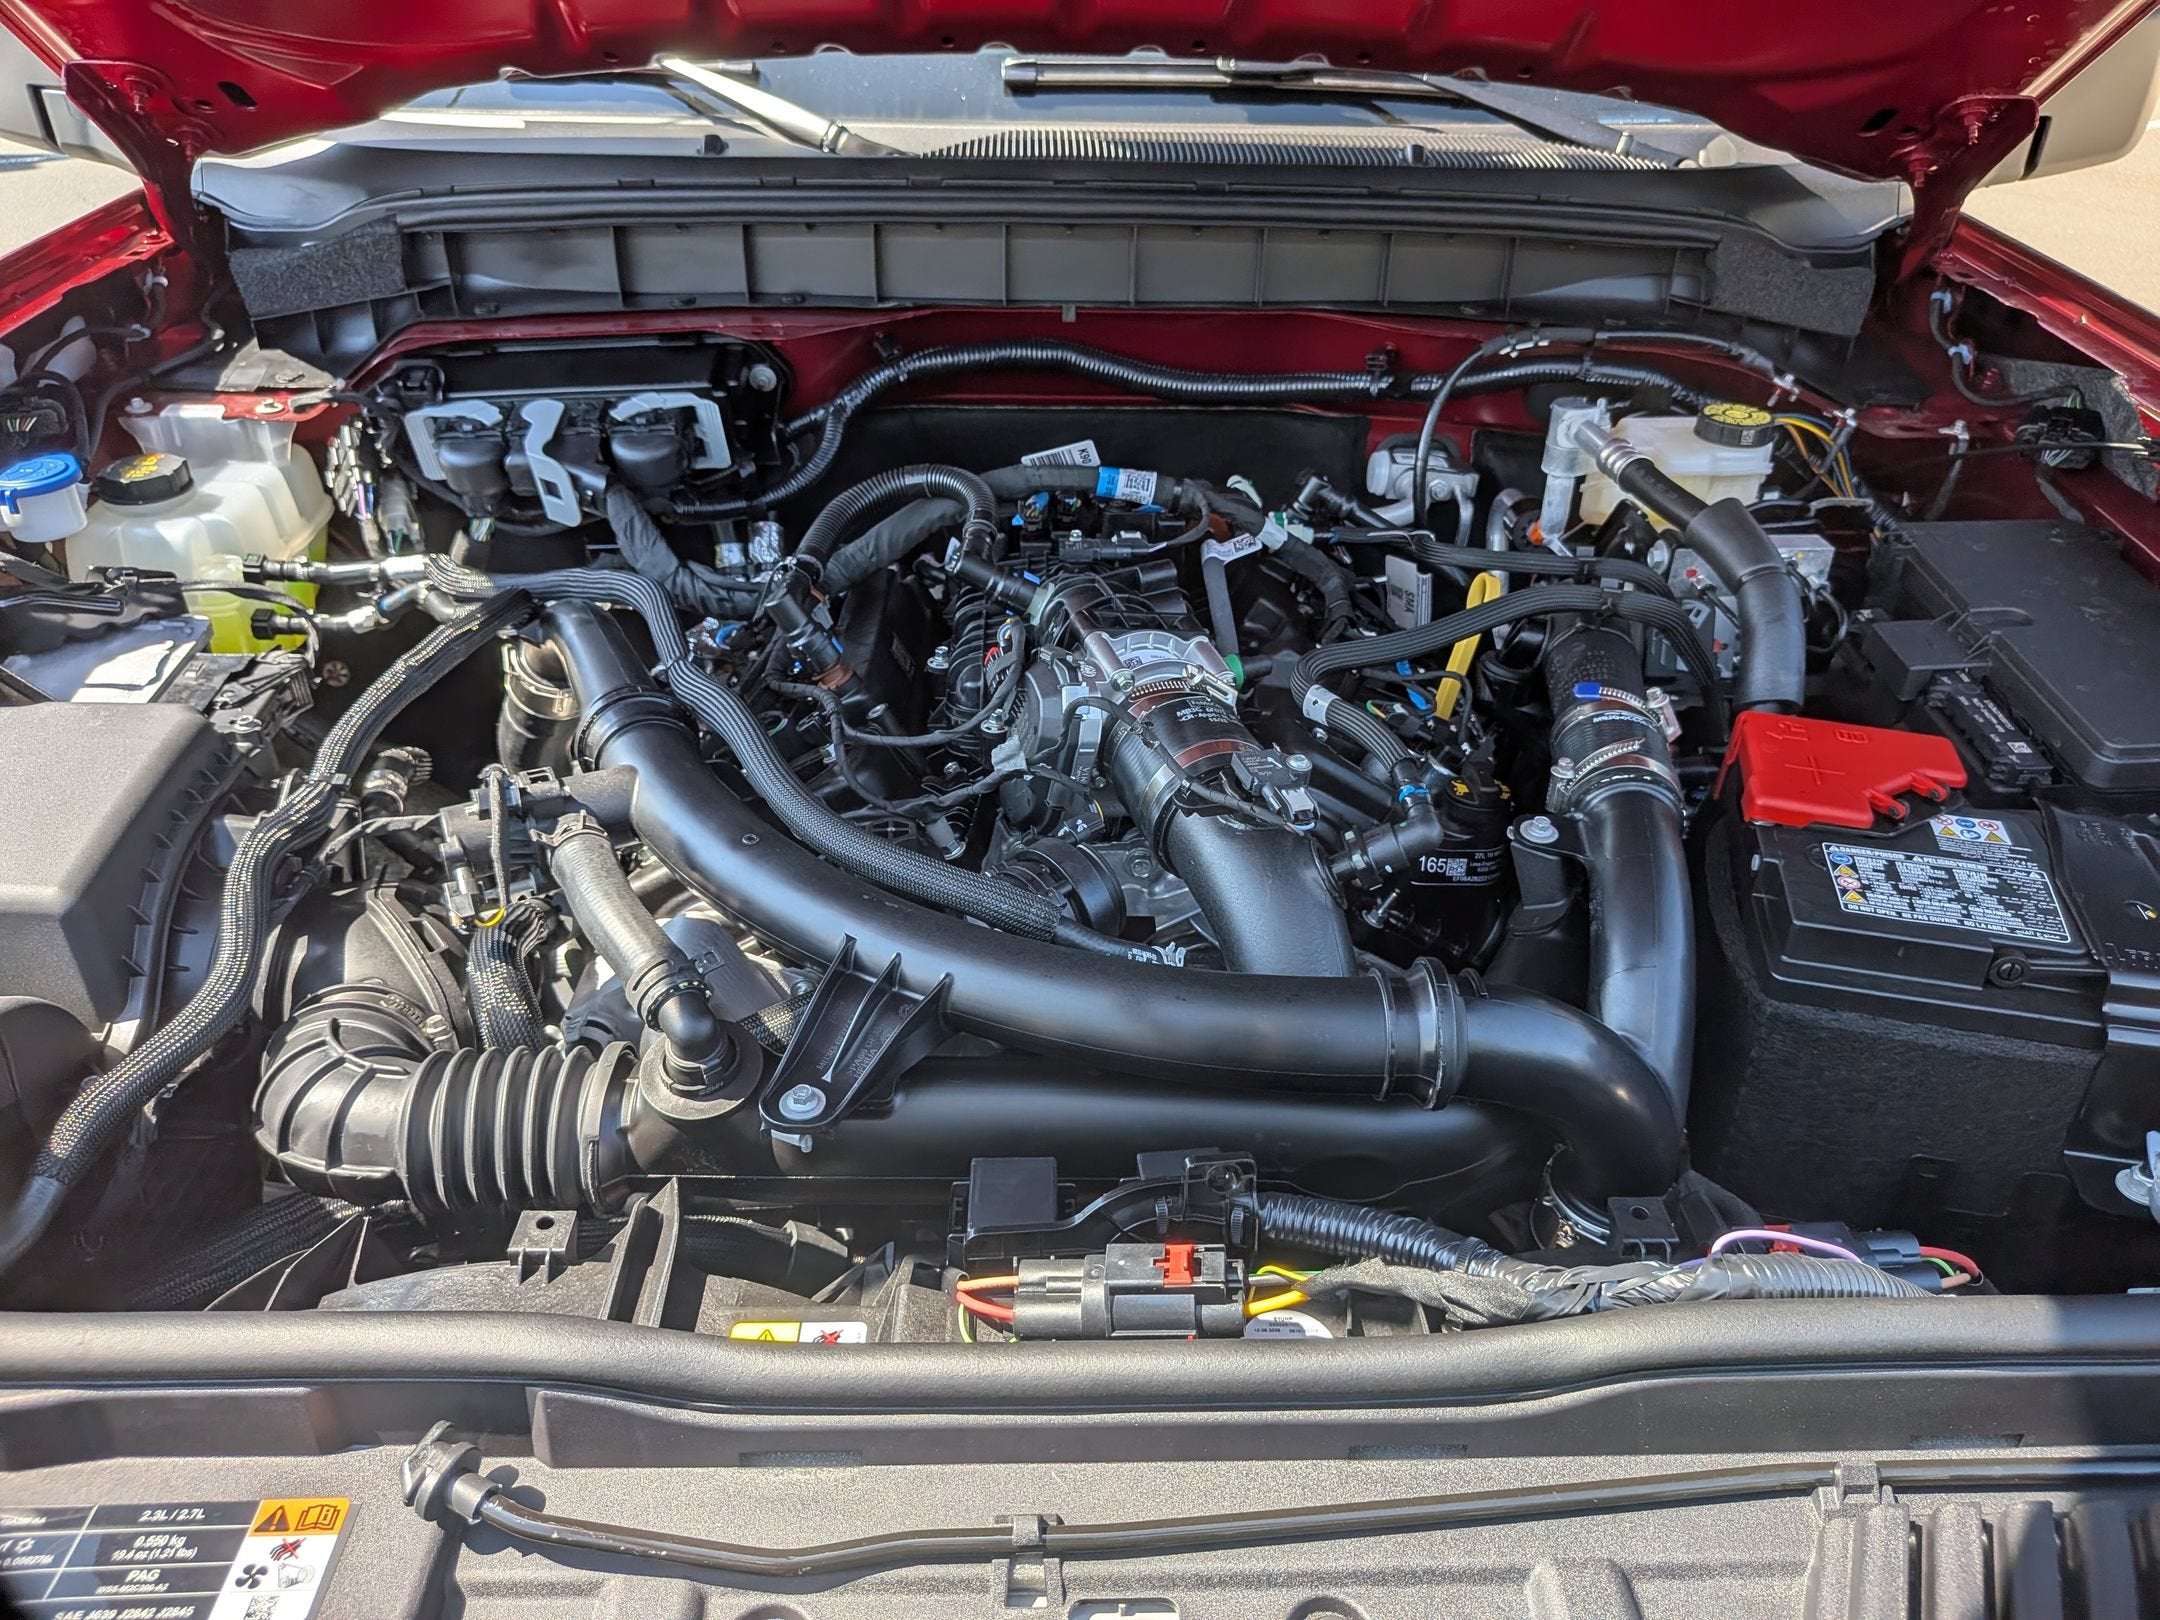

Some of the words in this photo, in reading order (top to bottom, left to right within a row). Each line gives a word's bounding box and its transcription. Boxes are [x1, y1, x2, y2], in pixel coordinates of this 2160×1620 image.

[1419, 855, 1447, 873] 165
[1963, 920, 1976, 928] NO
[1976, 921, 1987, 929] LA
[137, 1509, 169, 1522] 2.3L
[176, 1507, 206, 1521] 2.7L
[133, 1534, 170, 1548] 0.550
[168, 1533, 187, 1548] kg
[125, 1569, 161, 1582] PAG
[53, 1610, 87, 1620] SAE
